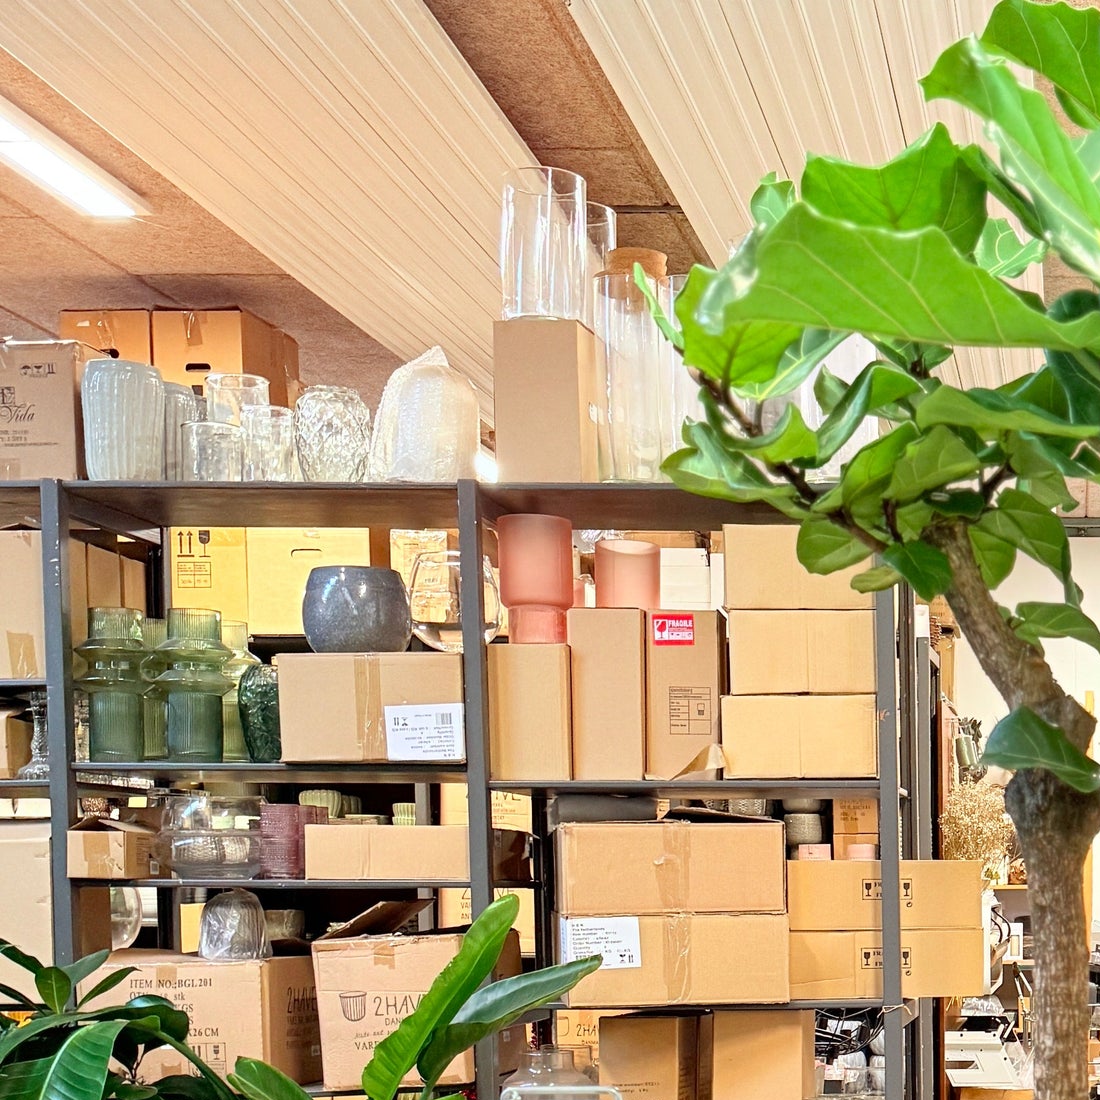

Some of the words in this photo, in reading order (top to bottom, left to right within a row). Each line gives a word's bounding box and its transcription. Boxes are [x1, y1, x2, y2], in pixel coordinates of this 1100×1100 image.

[0, 404, 36, 423] Vida
[668, 619, 693, 628] FRAGILE
[129, 979, 153, 989] ITEM
[173, 992, 186, 1001] stk
[373, 994, 426, 1017] 2HAV
[204, 1027, 219, 1037] CM
[576, 1023, 597, 1037] 2HA
